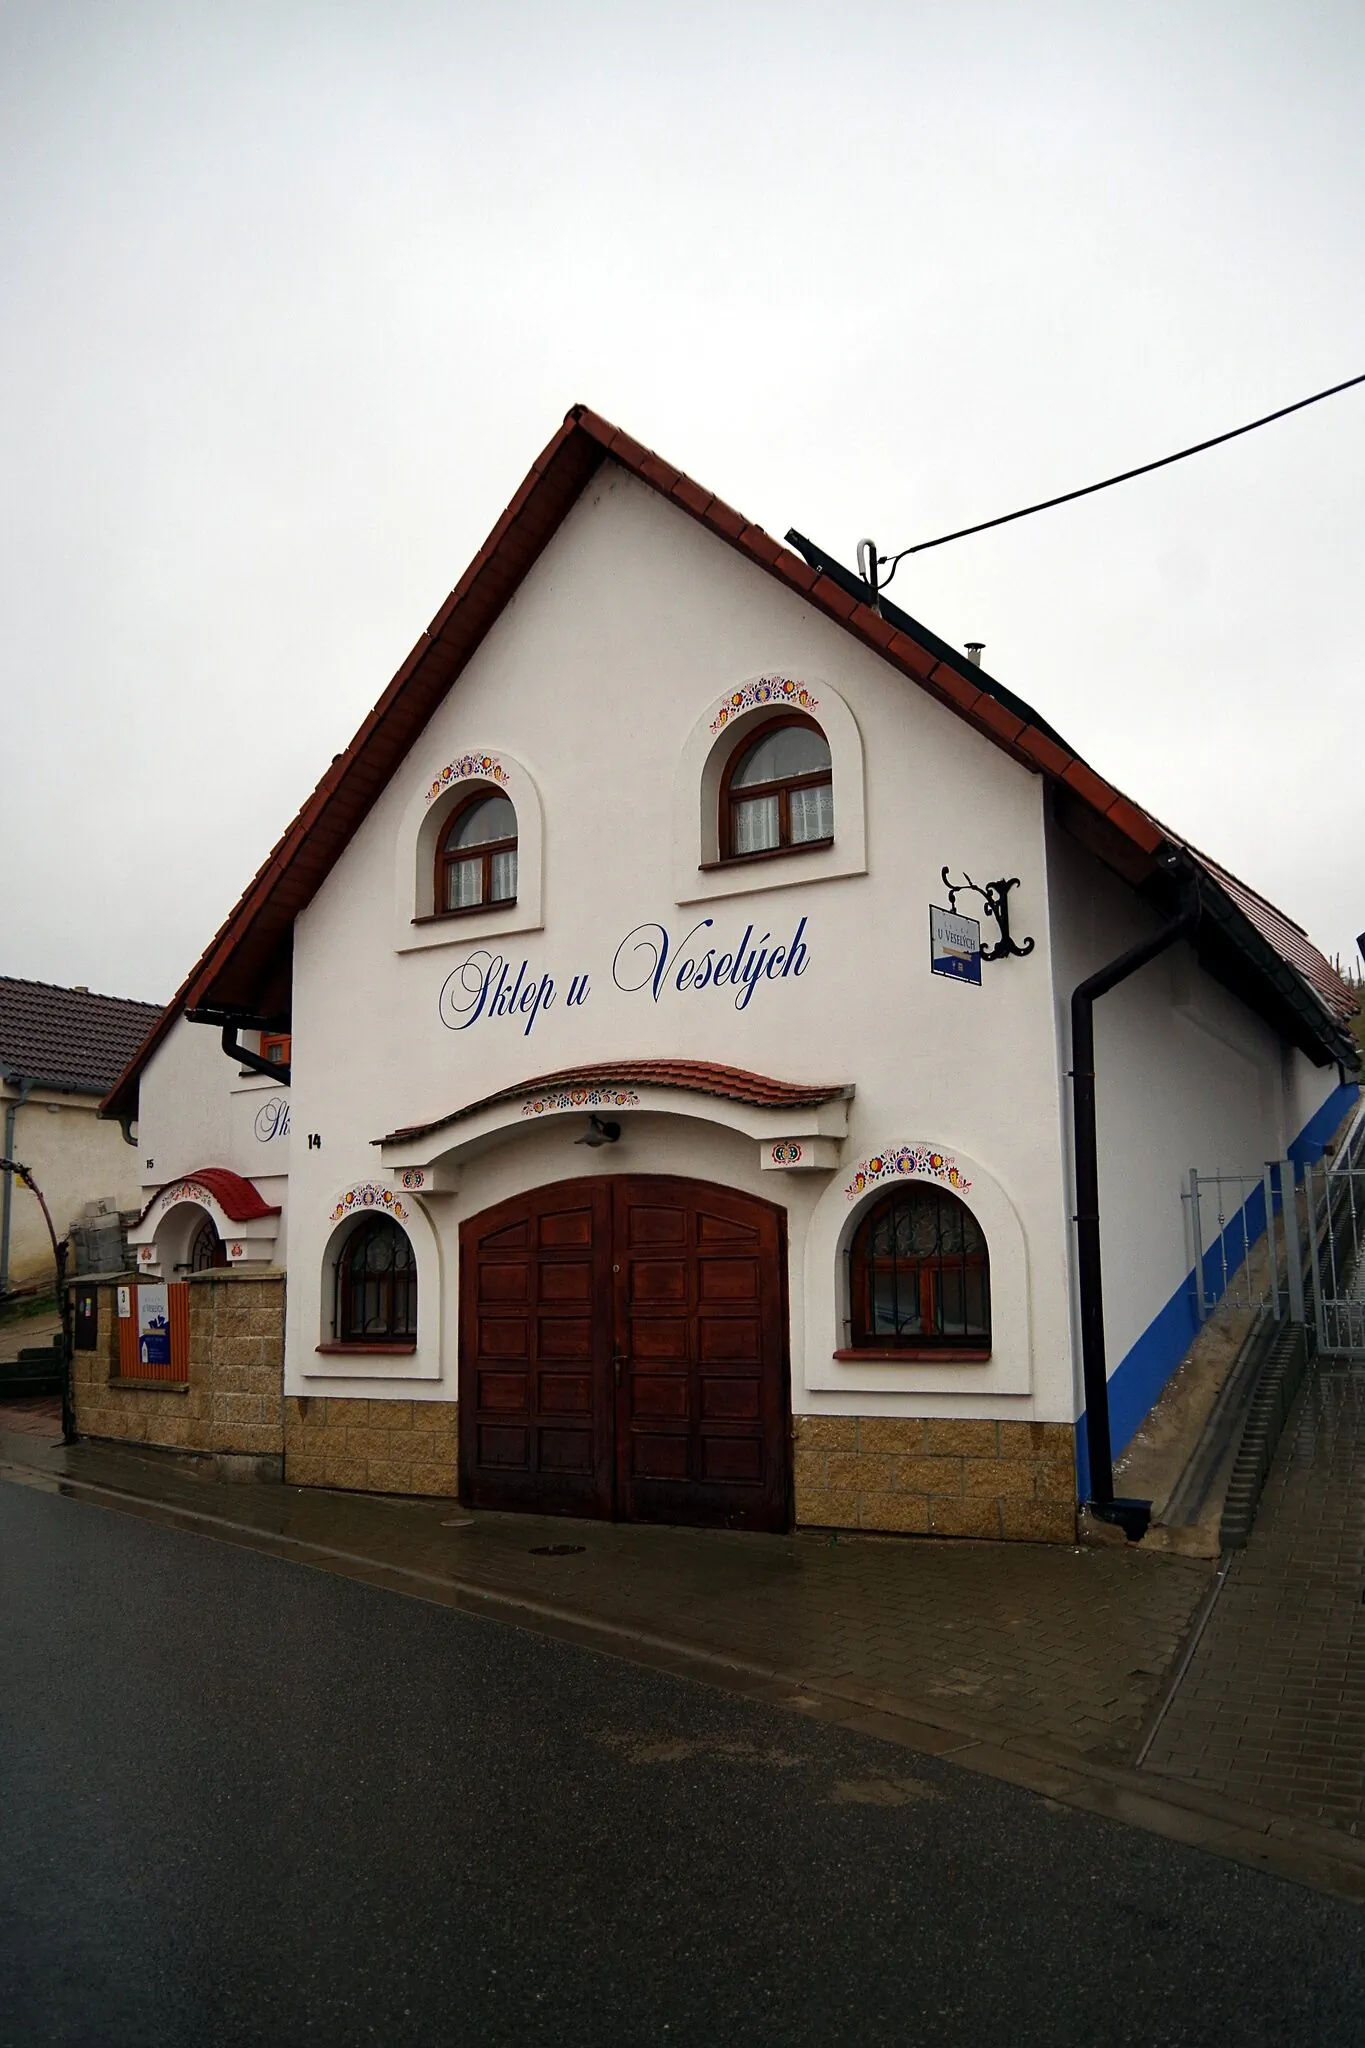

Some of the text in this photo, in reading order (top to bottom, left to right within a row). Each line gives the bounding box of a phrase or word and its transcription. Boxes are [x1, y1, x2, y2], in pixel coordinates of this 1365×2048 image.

[937, 928, 976, 950] U VESELÝCH
[439, 916, 811, 1036] Sklep u Veselých
[308, 1133, 321, 1150] 14
[146, 1158, 155, 1169] 15
